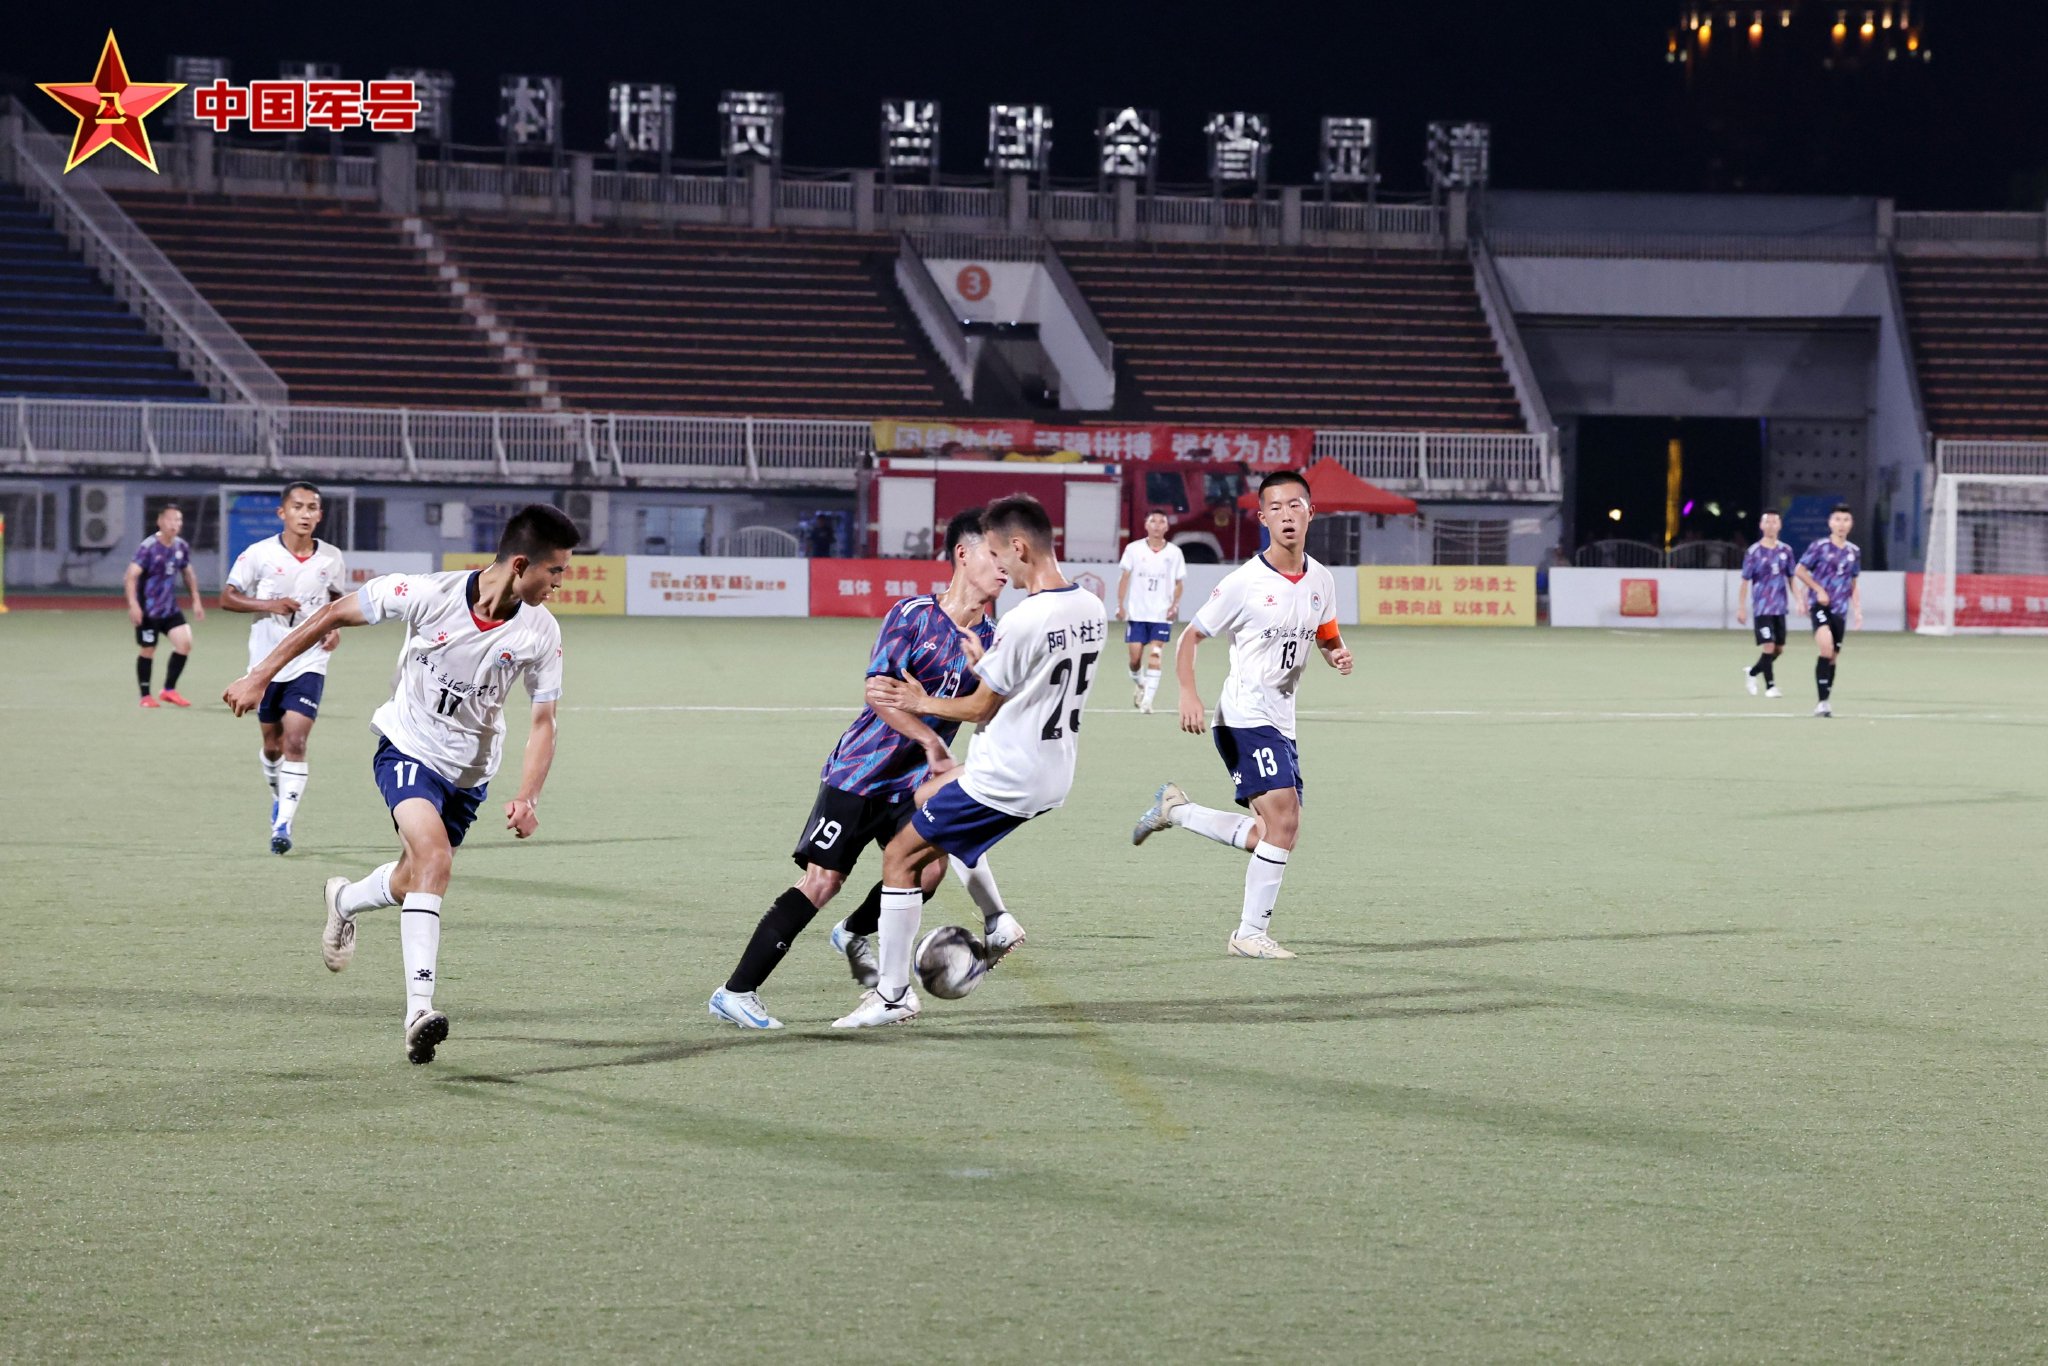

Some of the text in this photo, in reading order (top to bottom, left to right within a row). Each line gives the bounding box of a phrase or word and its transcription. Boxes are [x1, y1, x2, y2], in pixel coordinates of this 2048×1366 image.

[965, 271, 981, 296] 3
[1033, 430, 1153, 460] 顽强拼搏
[1148, 578, 1158, 591] 21
[1454, 576, 1516, 592] 沙场勇士
[1454, 600, 1516, 615] 以体育人
[1280, 640, 1298, 670] 13
[436, 687, 464, 717] 17
[1041, 651, 1098, 741] 25
[394, 760, 419, 789] 17
[1252, 747, 1278, 778] 13
[809, 816, 842, 850] 19
